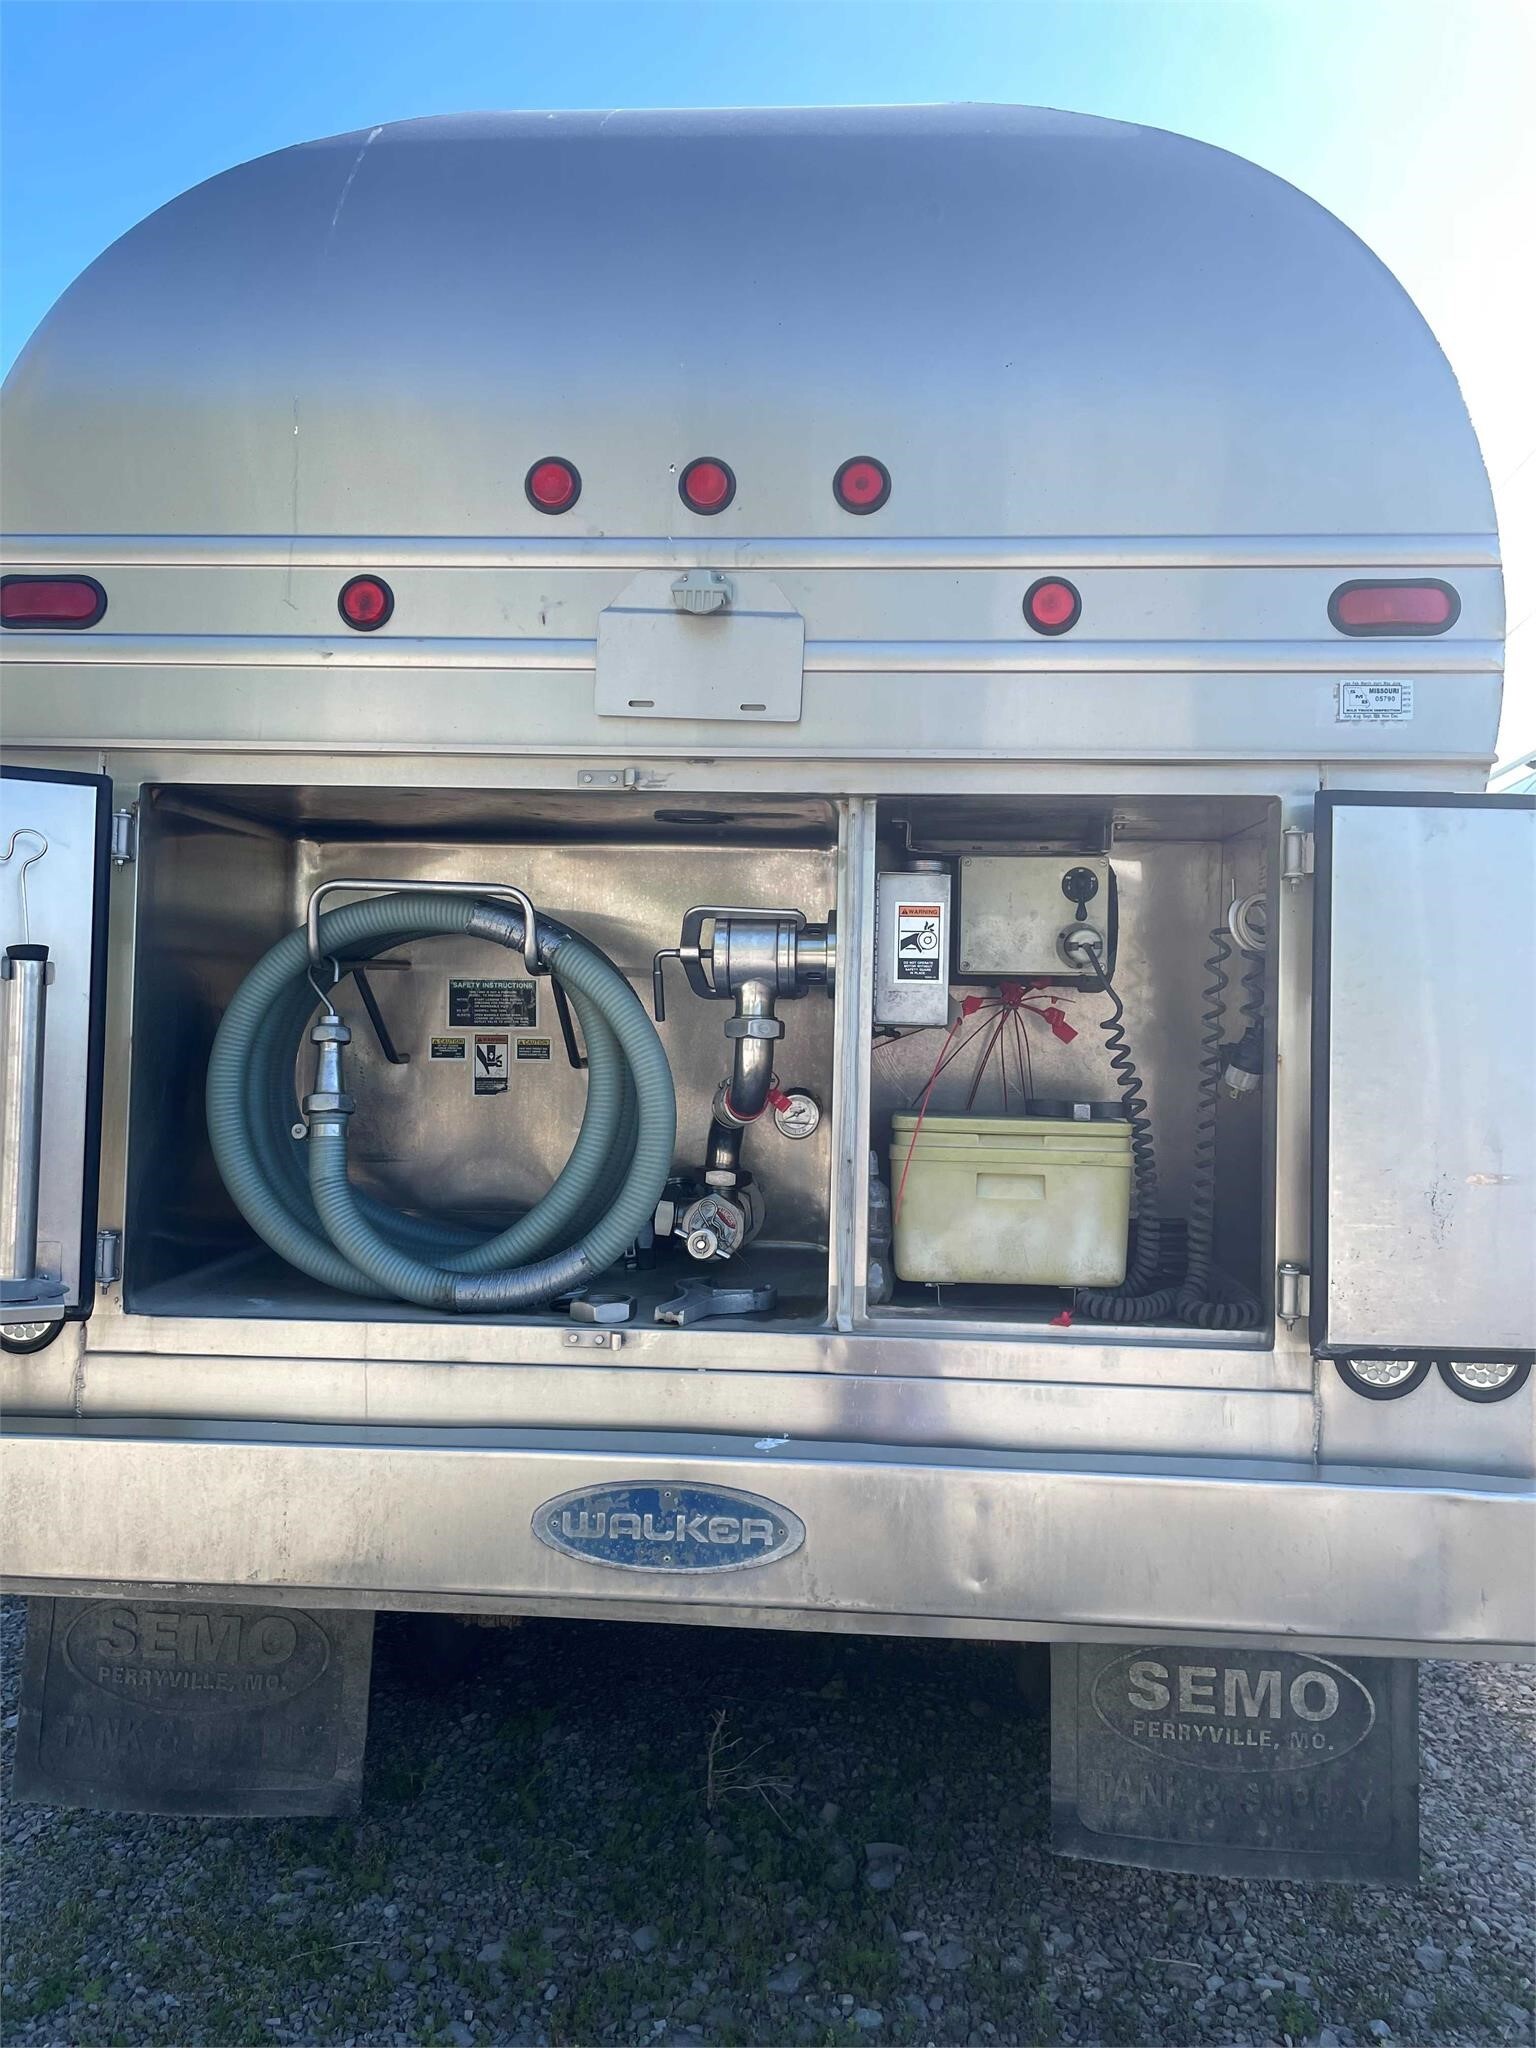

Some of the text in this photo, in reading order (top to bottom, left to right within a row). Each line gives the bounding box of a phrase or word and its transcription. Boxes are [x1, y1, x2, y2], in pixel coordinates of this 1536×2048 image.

[561, 1511, 774, 1546] WALKER
[96, 1607, 298, 1665] SEMO
[97, 1666, 288, 1693] PERRYVILLE, MO.
[1127, 1661, 1340, 1722] SEMO
[59, 1713, 143, 1751] TANK
[1132, 1719, 1334, 1751] PERRYVILLE, MO.
